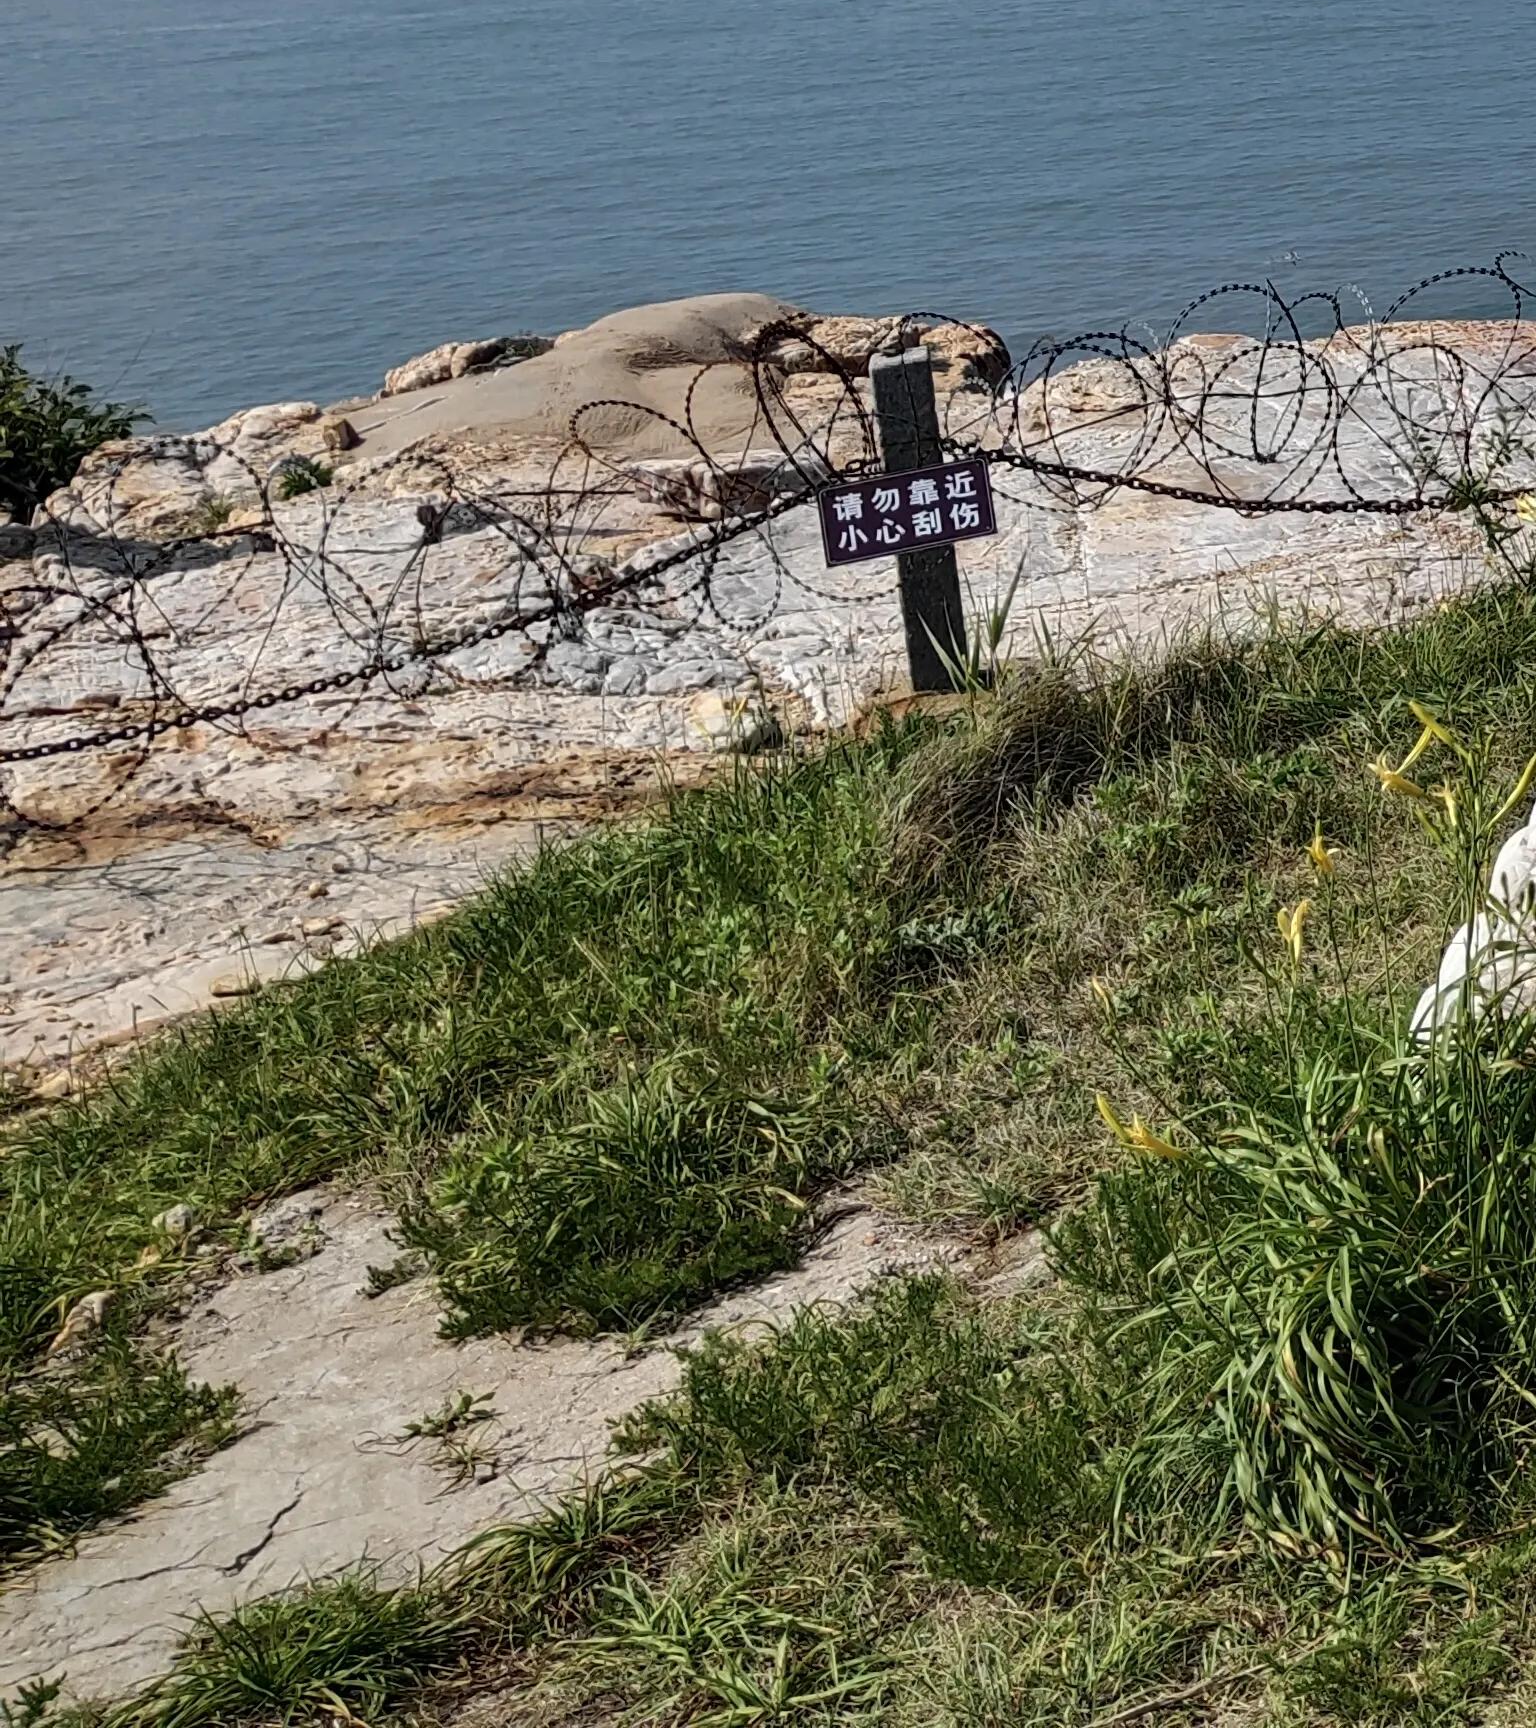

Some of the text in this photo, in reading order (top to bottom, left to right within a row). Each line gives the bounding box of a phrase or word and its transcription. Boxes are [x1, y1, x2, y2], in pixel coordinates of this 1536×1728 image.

[832, 470, 978, 522] 请勿靠近
[837, 502, 981, 552] 小心刮伤
